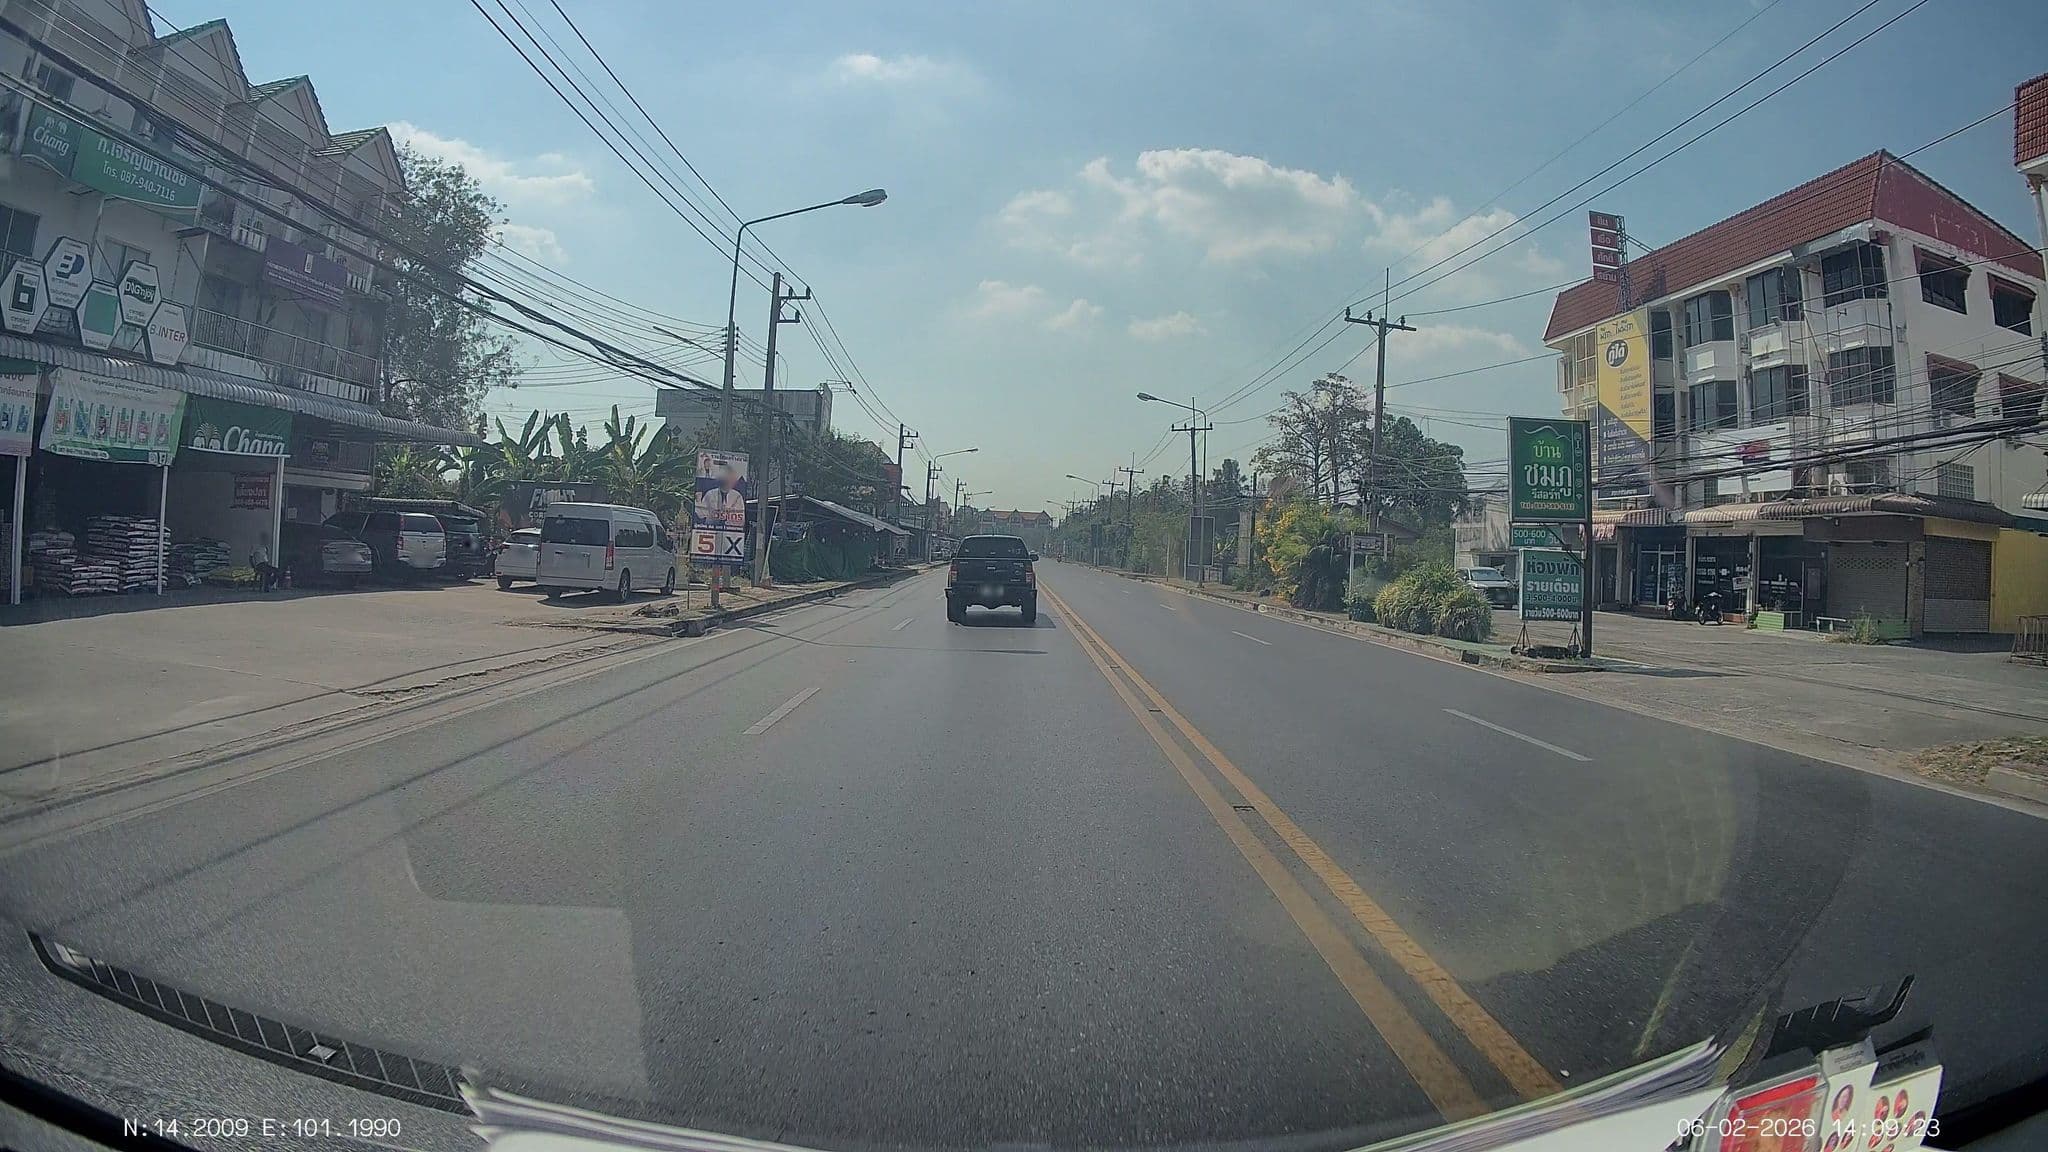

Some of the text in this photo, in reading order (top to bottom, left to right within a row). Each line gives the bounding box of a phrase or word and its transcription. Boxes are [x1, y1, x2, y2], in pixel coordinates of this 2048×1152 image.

[33, 126, 70, 156] Chang
[120, 169, 176, 201] 087-940-7116
[149, 324, 186, 343] B.INTER
[223, 425, 285, 455] Chang
[1533, 440, 1562, 459] บ้าน
[1524, 463, 1572, 497] ชมภู
[1513, 529, 1546, 538] 500-600
[697, 534, 715, 554] 5
[1526, 557, 1580, 576] ห้องพัก
[1526, 578, 1579, 593] รายเดือน
